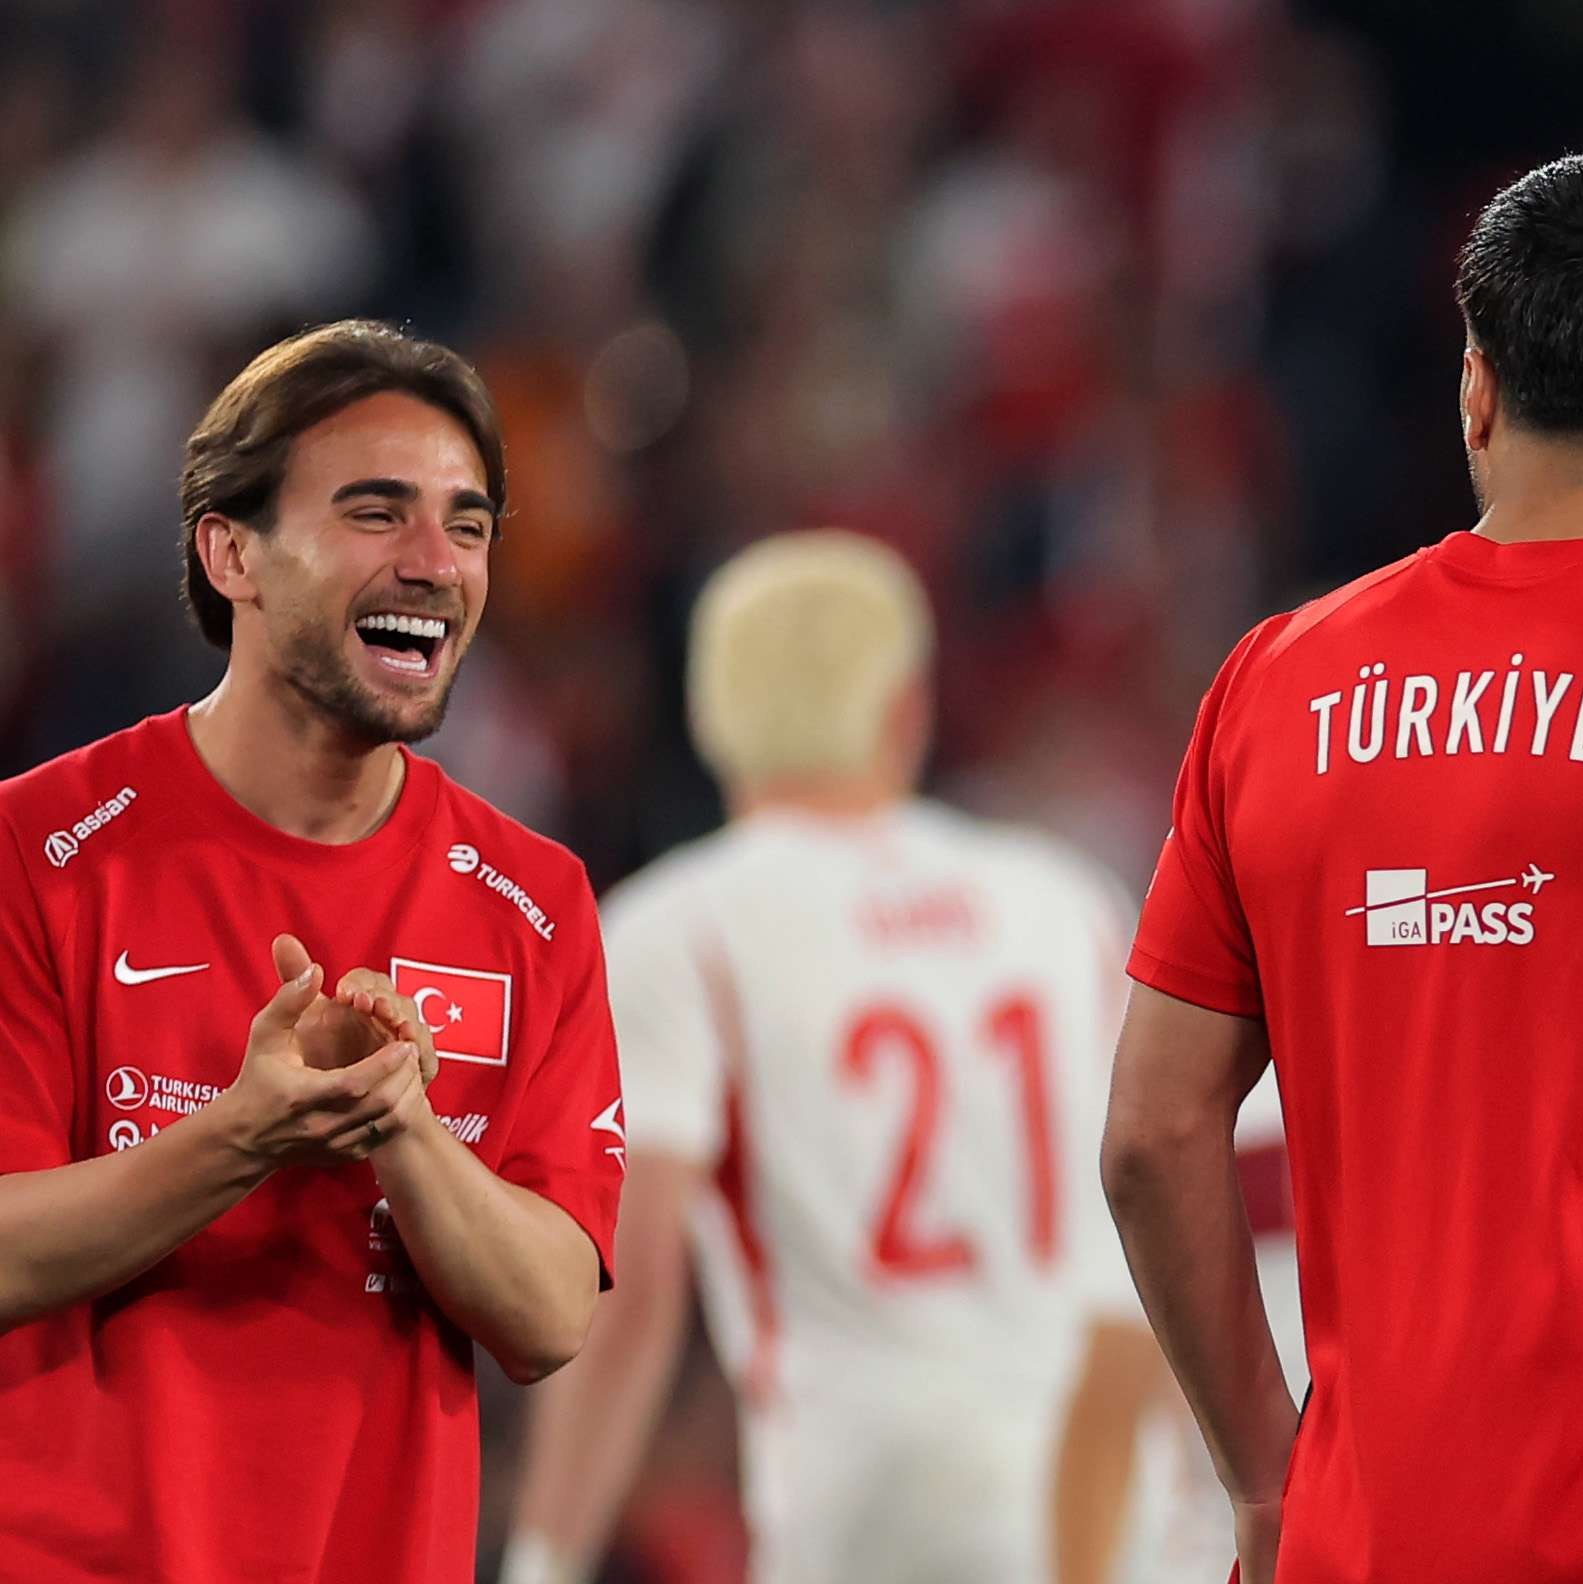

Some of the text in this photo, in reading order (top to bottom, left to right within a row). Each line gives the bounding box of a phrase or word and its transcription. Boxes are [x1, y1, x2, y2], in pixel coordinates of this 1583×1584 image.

[72, 787, 138, 840] assan
[476, 863, 556, 942] TURKCELL
[1431, 902, 1535, 945] PASS
[836, 985, 1064, 1288] 21
